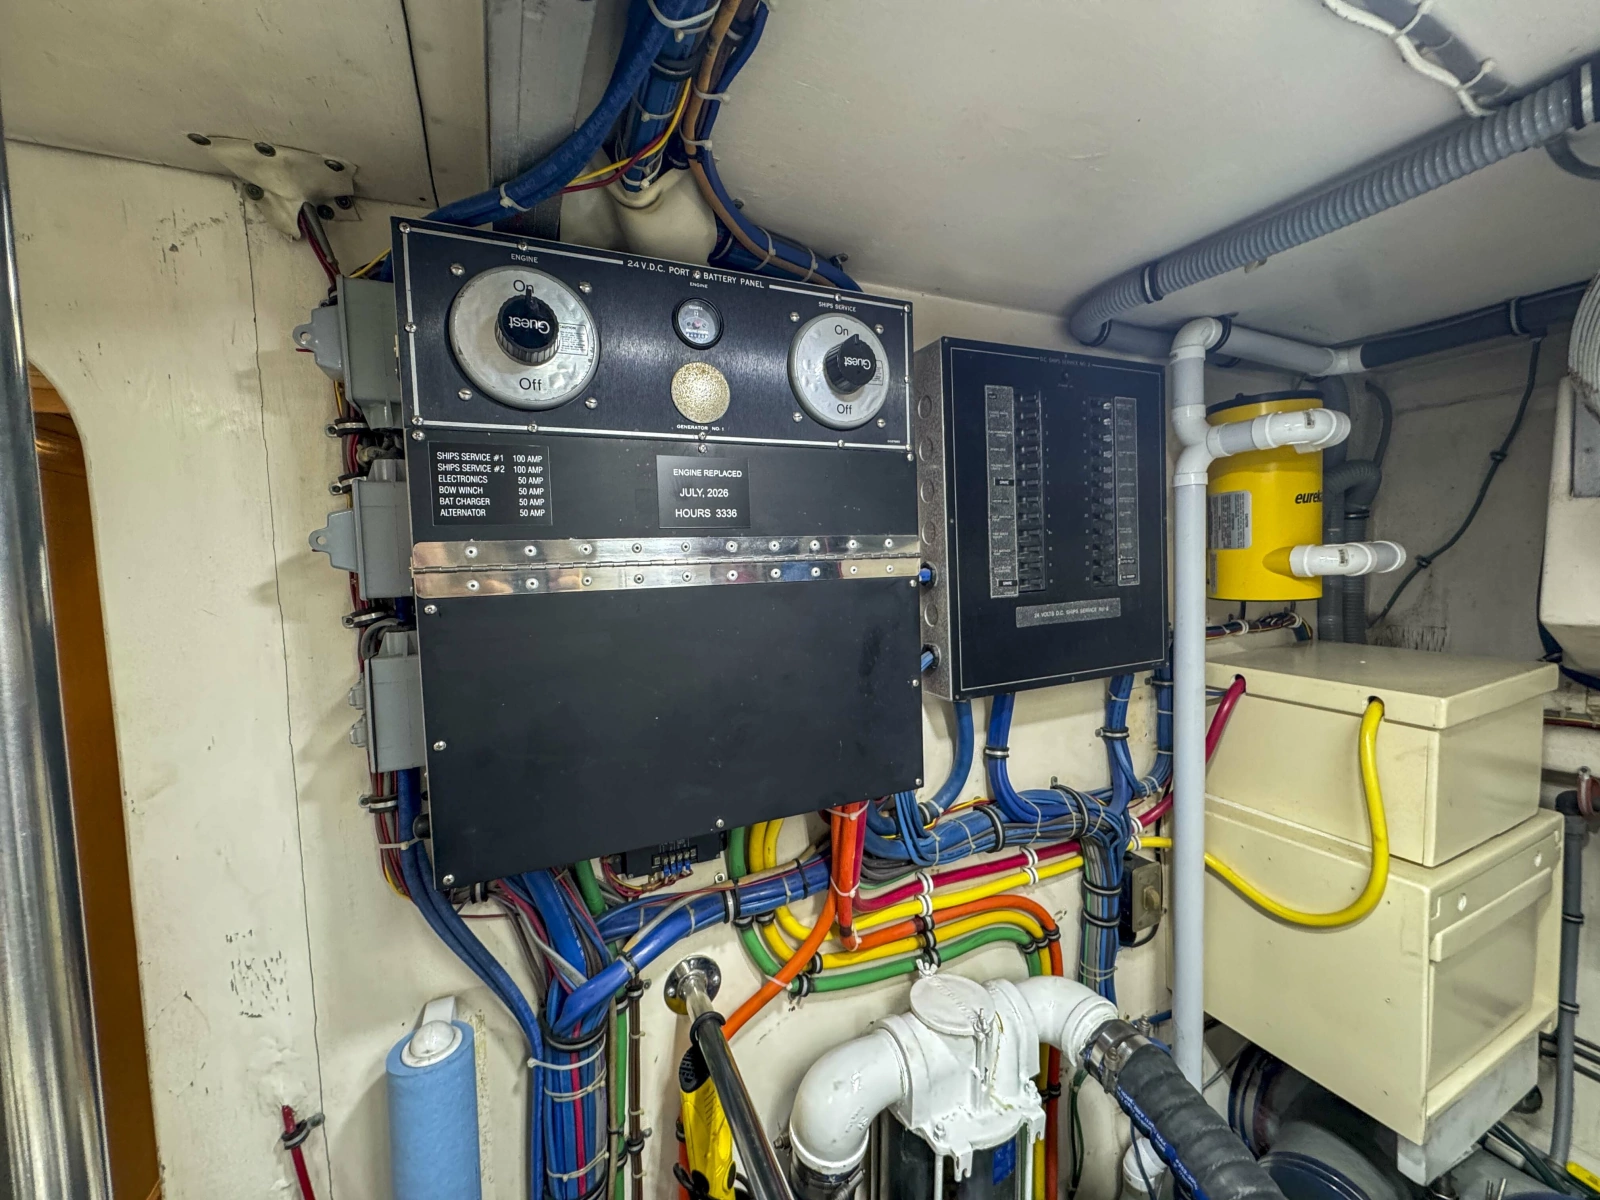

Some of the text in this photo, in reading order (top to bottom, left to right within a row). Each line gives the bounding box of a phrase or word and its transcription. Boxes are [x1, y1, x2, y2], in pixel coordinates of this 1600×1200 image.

[511, 253, 538, 264] ENGINE
[669, 266, 690, 277] PORT
[703, 271, 737, 285] BATTERY
[740, 278, 765, 289] PANEL
[513, 279, 535, 294] On
[689, 281, 709, 289] ENGINE
[818, 301, 857, 312] SHIPS SERVICE
[508, 316, 550, 334] Guest
[834, 324, 849, 336] On
[843, 356, 871, 370] Guest
[519, 377, 542, 391] Off
[836, 403, 853, 415] Off
[436, 451, 543, 463] SHIPS SERVICE #1 100 AMP
[437, 463, 543, 474] SHIPS SERVICE #2 100 AMP
[673, 468, 743, 478] ENGINE REPLACED
[438, 474, 544, 485] ELECTRONICS 50 AMP
[438, 485, 544, 495] BOW WINCH 50 AMP
[679, 487, 729, 498] JULY, 2026
[439, 497, 545, 506] BAT CHARGER 50 AMP
[440, 508, 546, 517] ALTERNATOR 50 AMP
[675, 508, 738, 518] HOURS 3336
